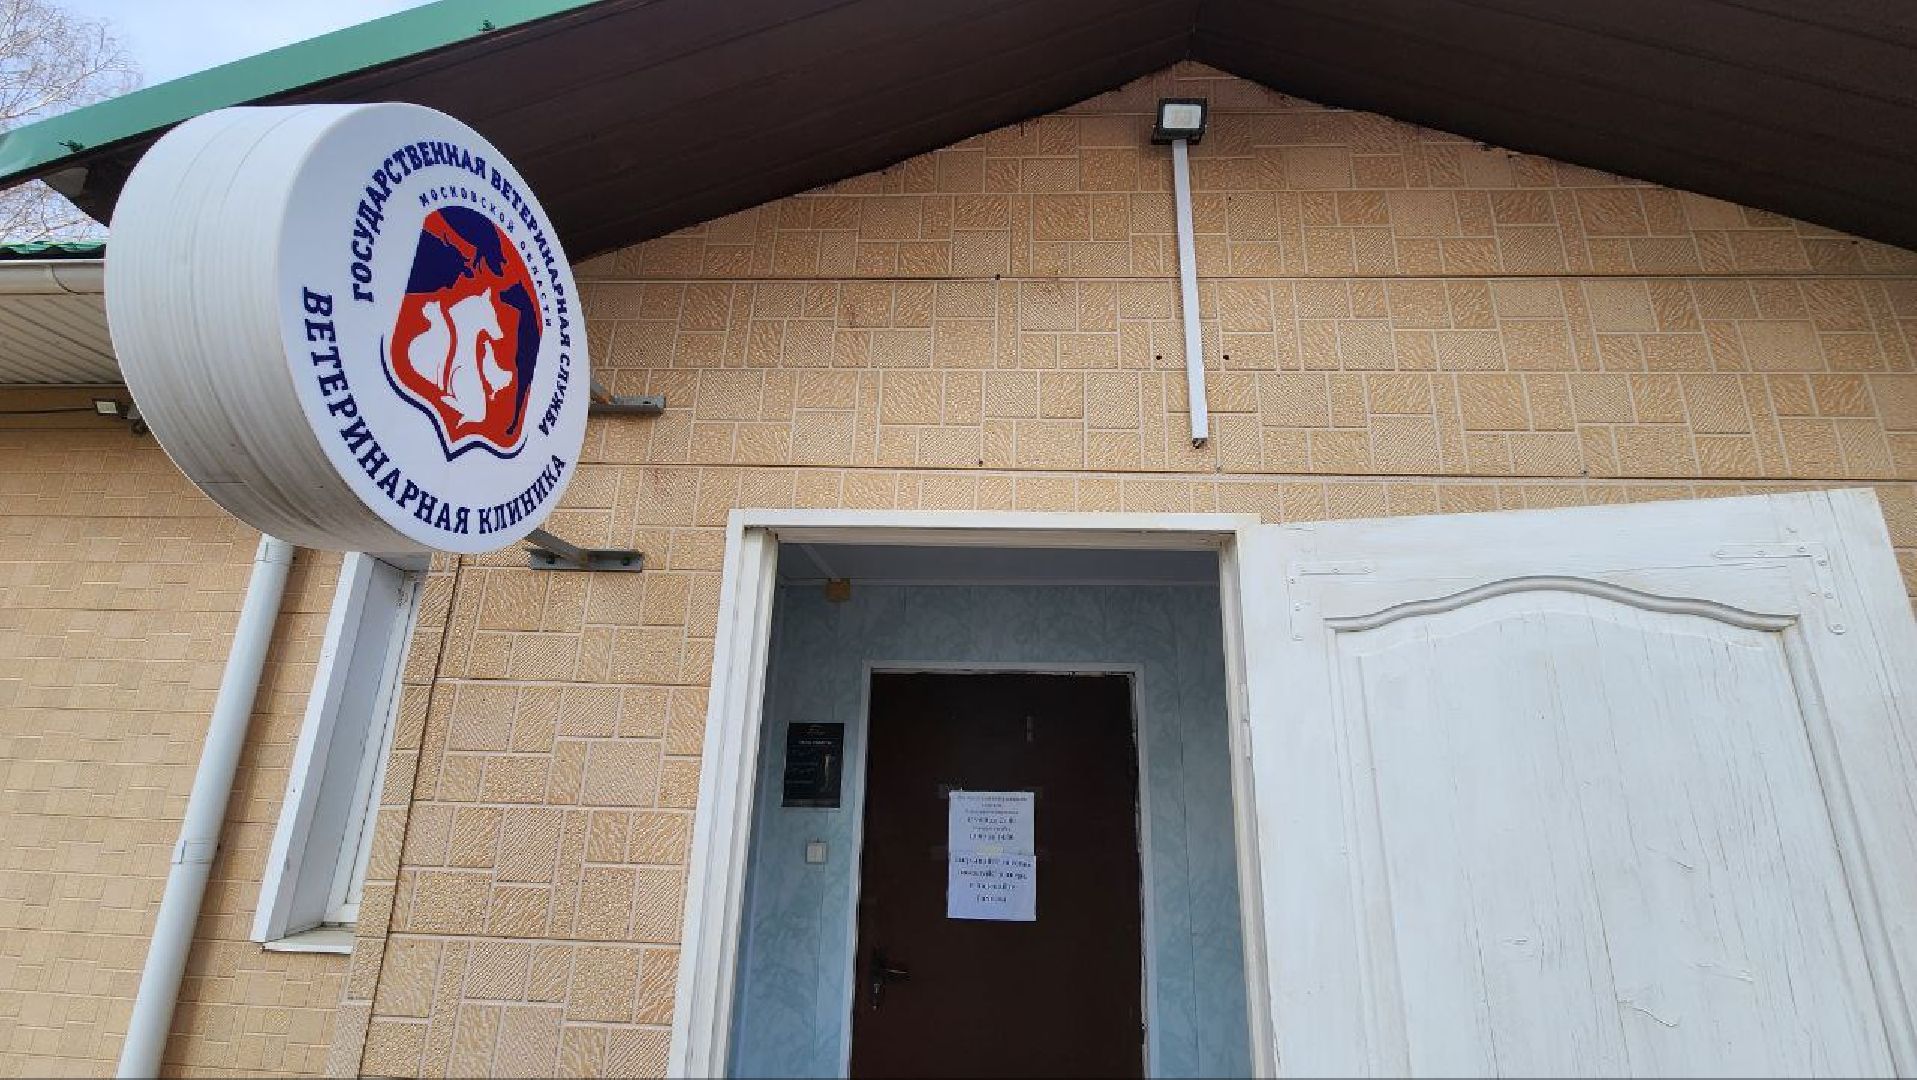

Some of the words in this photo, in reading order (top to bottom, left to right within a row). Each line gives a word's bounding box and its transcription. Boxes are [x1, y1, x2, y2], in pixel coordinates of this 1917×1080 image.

[349, 140, 487, 303] ГОСУДАРСТВЕННАЯ
[491, 168, 570, 347] ВЕТЕРИНАРНАЯ
[537, 353, 570, 437] СЛУЖБА
[418, 185, 516, 234] МОСКОВСКОЙ
[519, 240, 553, 328] ОБЛАСТИ
[302, 287, 472, 535] ВЕТЕРИНАРНАЯ
[478, 454, 567, 535] КЛИНИКА
